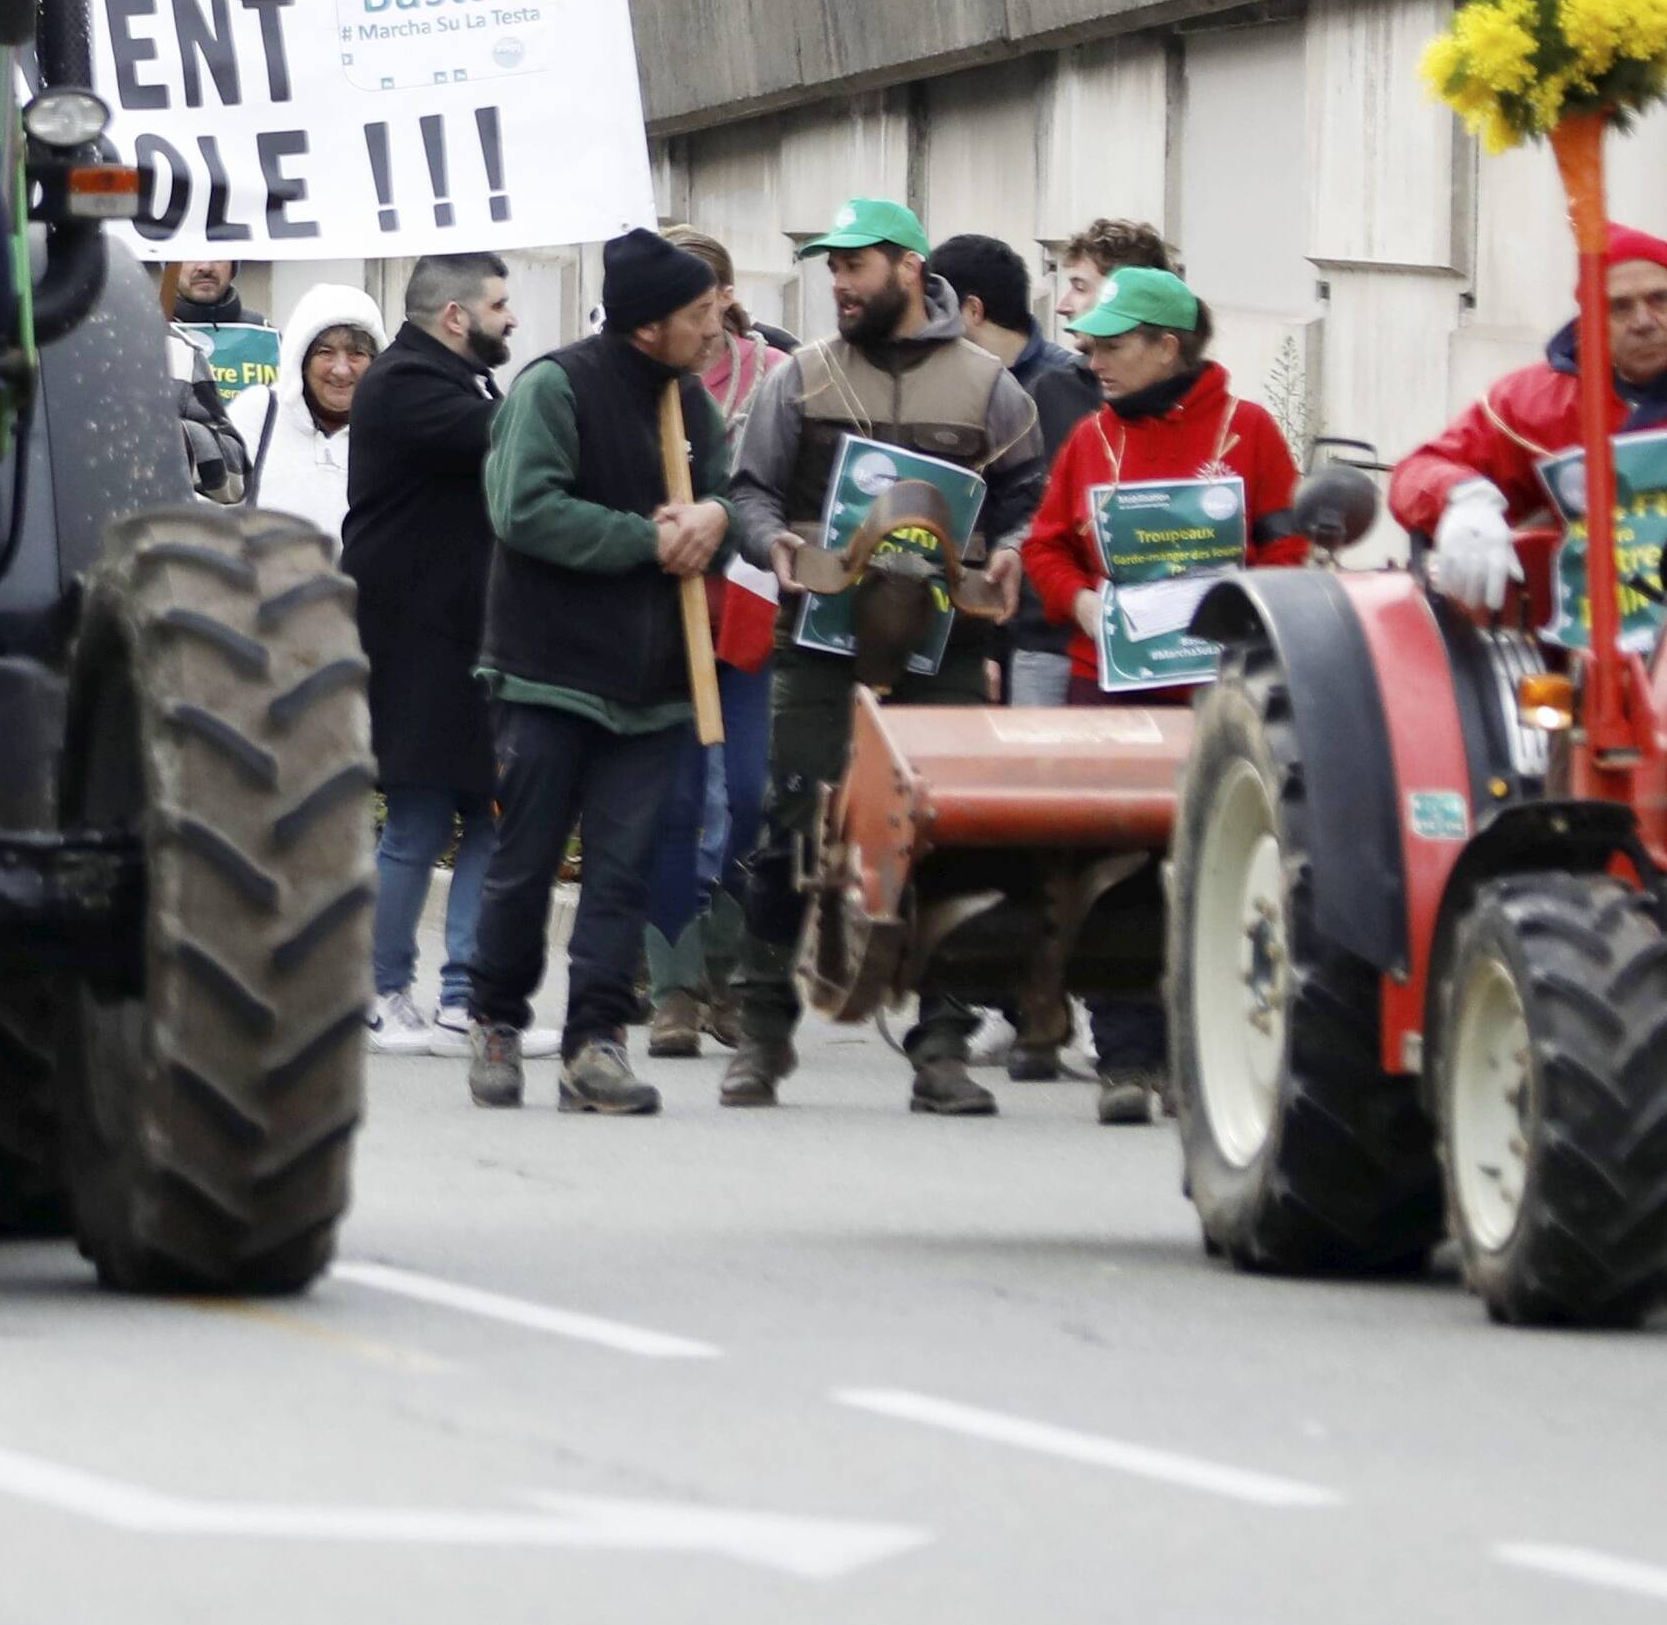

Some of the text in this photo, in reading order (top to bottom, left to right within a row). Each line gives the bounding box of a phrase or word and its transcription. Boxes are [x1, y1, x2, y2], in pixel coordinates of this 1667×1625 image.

[357, 18, 432, 41] Marcha
[437, 16, 460, 33] Su
[466, 13, 487, 29] La
[491, 6, 541, 26] Testa
[131, 129, 321, 241] OLE
[209, 363, 238, 383] tre
[1134, 527, 1216, 546] Troupeaux
